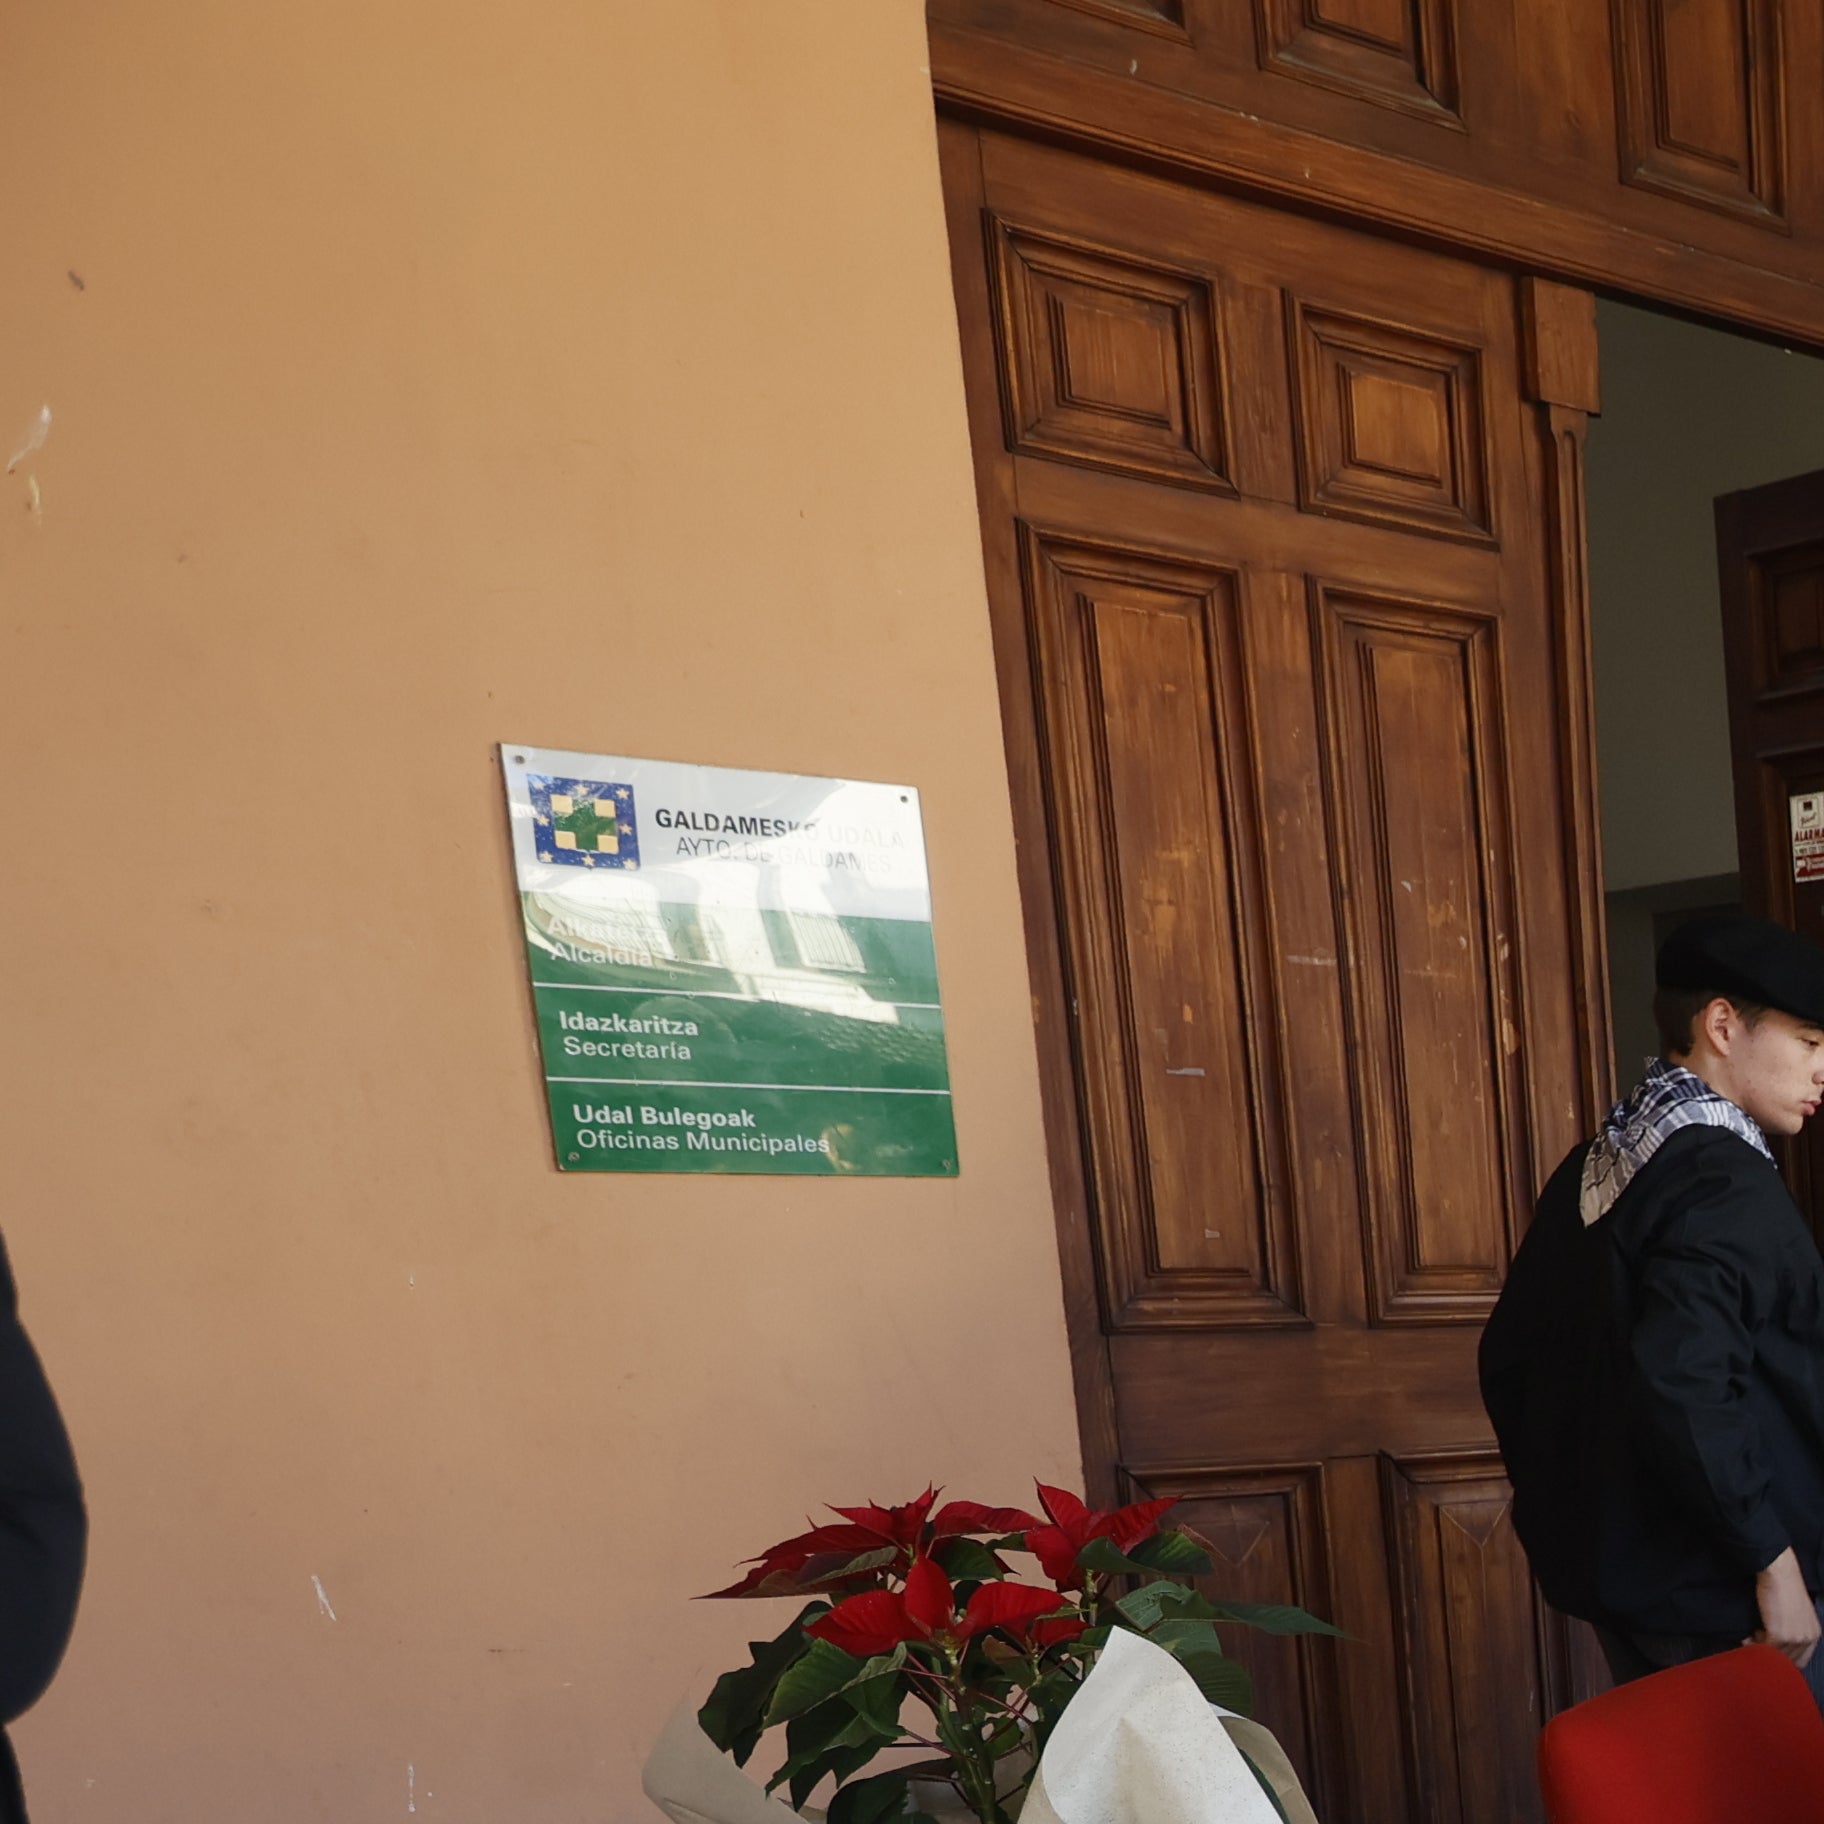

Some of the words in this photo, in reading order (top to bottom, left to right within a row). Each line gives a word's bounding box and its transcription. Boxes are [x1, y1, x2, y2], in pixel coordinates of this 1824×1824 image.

[655, 809, 817, 839] GALDAMESKO
[676, 837, 738, 860] AYTO.
[559, 1010, 699, 1036] Idazkaritza
[563, 1036, 691, 1060] Secretaría
[573, 1103, 633, 1125] Udal
[640, 1106, 756, 1130] Bulegoak
[576, 1129, 680, 1150] Oficinas
[686, 1131, 830, 1156] Municipales
